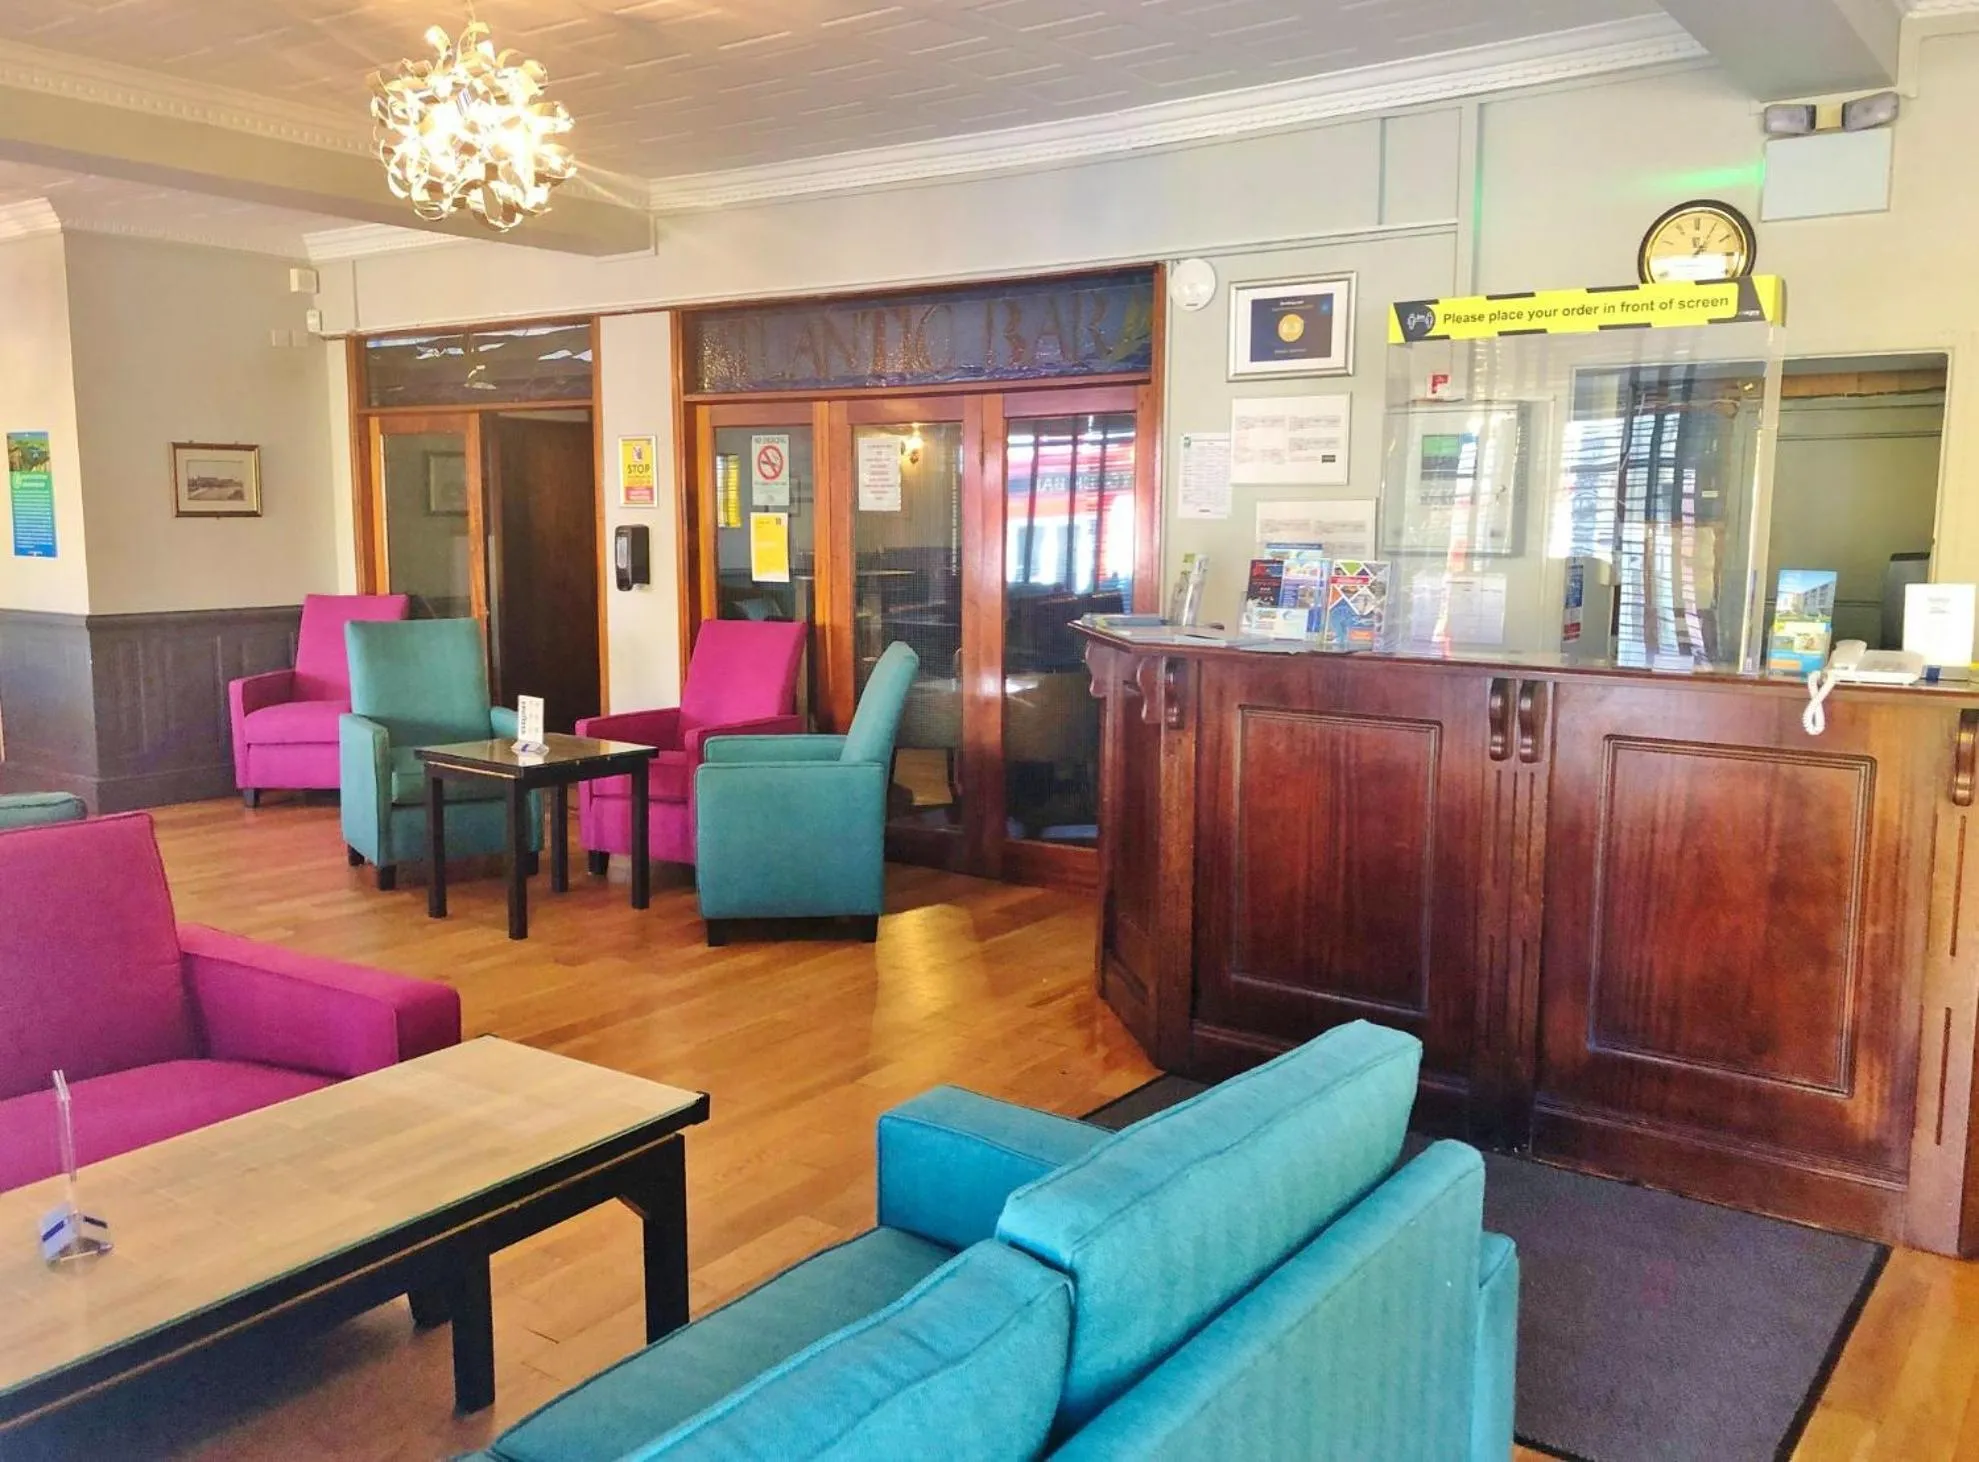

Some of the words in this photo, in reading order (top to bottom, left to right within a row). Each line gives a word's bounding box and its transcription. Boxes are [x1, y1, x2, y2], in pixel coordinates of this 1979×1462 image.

[1443, 313, 1485, 324] Please
[1489, 310, 1524, 323] place
[1528, 308, 1558, 321] your
[1562, 304, 1599, 317] order
[1603, 304, 1616, 315] in
[1620, 300, 1655, 313] front
[1658, 298, 1674, 311] of
[1678, 297, 1729, 309] screen
[981, 291, 1113, 368] BAR
[627, 464, 651, 474] STOP
